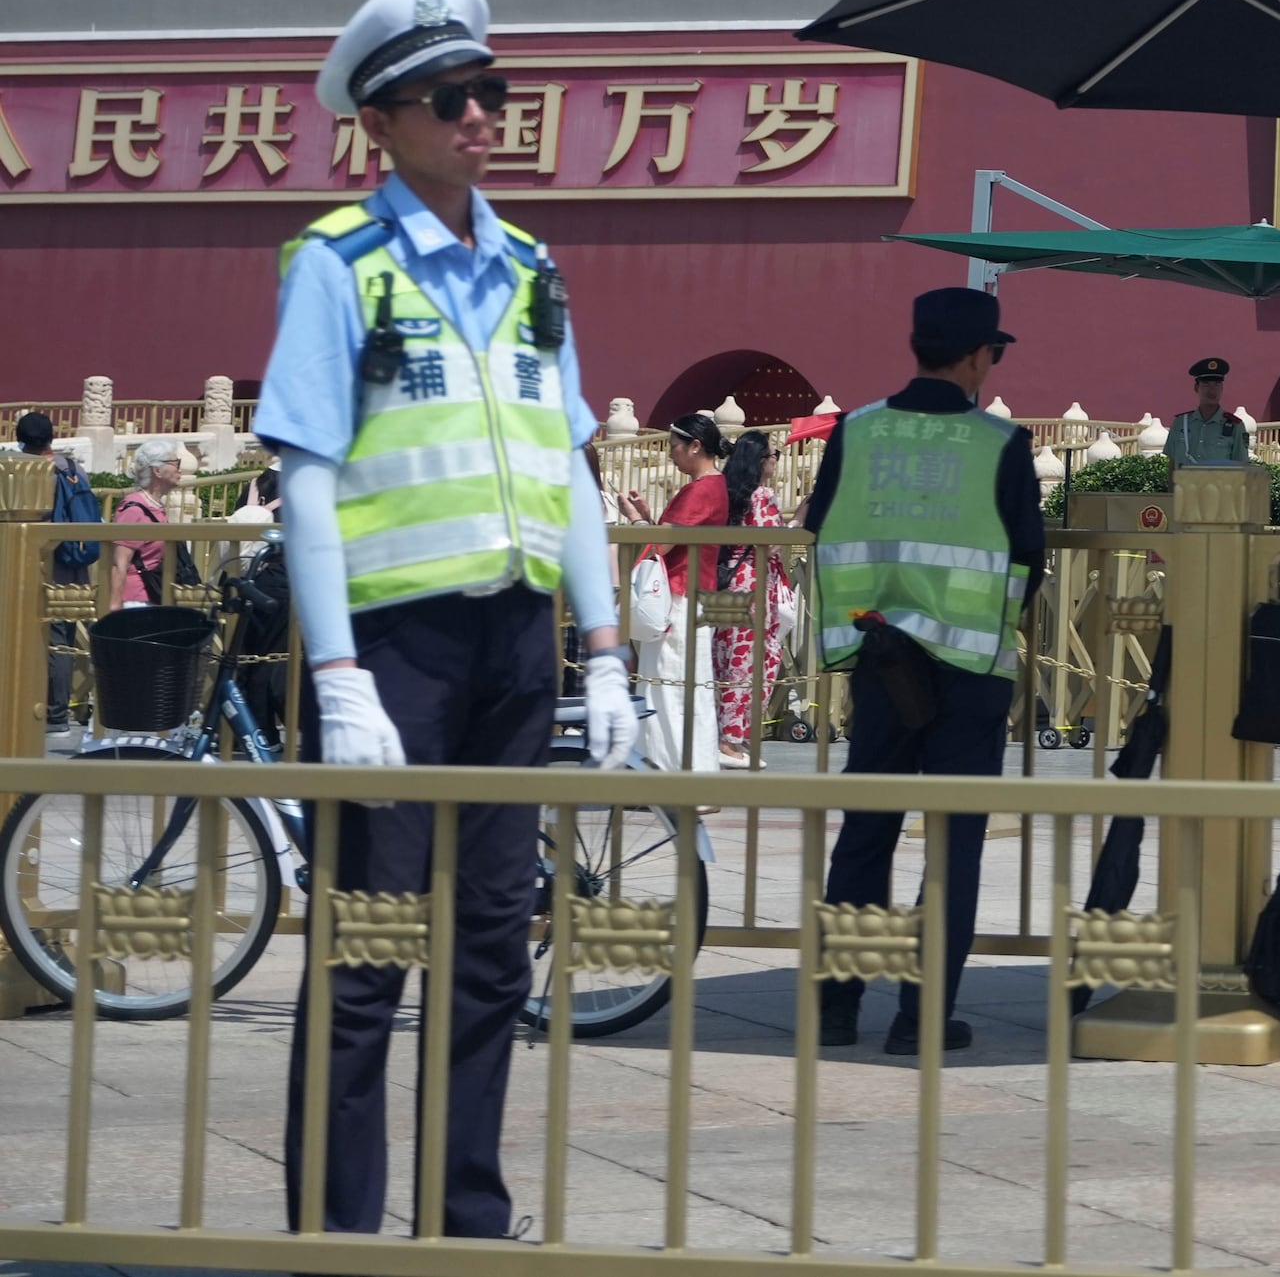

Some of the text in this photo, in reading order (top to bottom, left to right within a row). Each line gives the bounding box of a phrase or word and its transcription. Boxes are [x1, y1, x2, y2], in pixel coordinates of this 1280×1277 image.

[0, 79, 840, 178] 民共国万岁
[869, 444, 963, 495] 执勤
